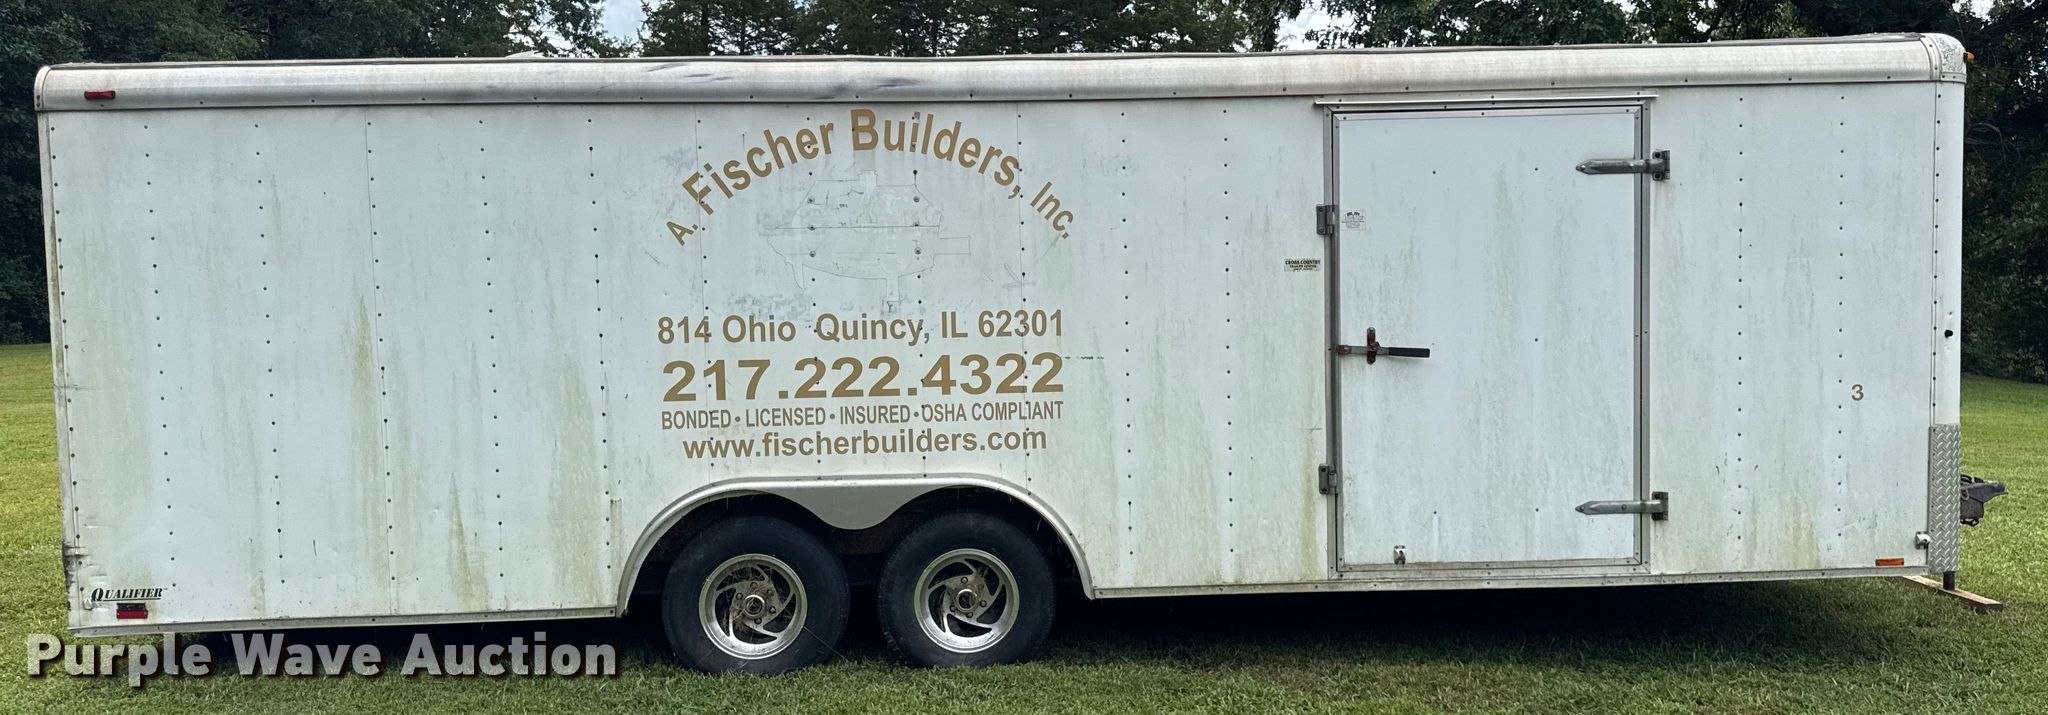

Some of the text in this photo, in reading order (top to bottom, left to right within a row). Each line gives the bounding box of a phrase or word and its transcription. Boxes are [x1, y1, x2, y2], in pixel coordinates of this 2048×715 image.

[665, 108, 1074, 247] A. Fischer Builders, Inc.
[657, 309, 1063, 347] 814 Ohio Quincy, IL 62301
[662, 352, 1064, 402] 217.222.4322
[1851, 384, 1864, 401] 3
[661, 401, 1064, 430] BONDED LICENSED INSURED OSHA COMPLIANT
[683, 427, 1047, 459] www.fischerbuilders.com
[91, 587, 163, 602] QUALIFIER
